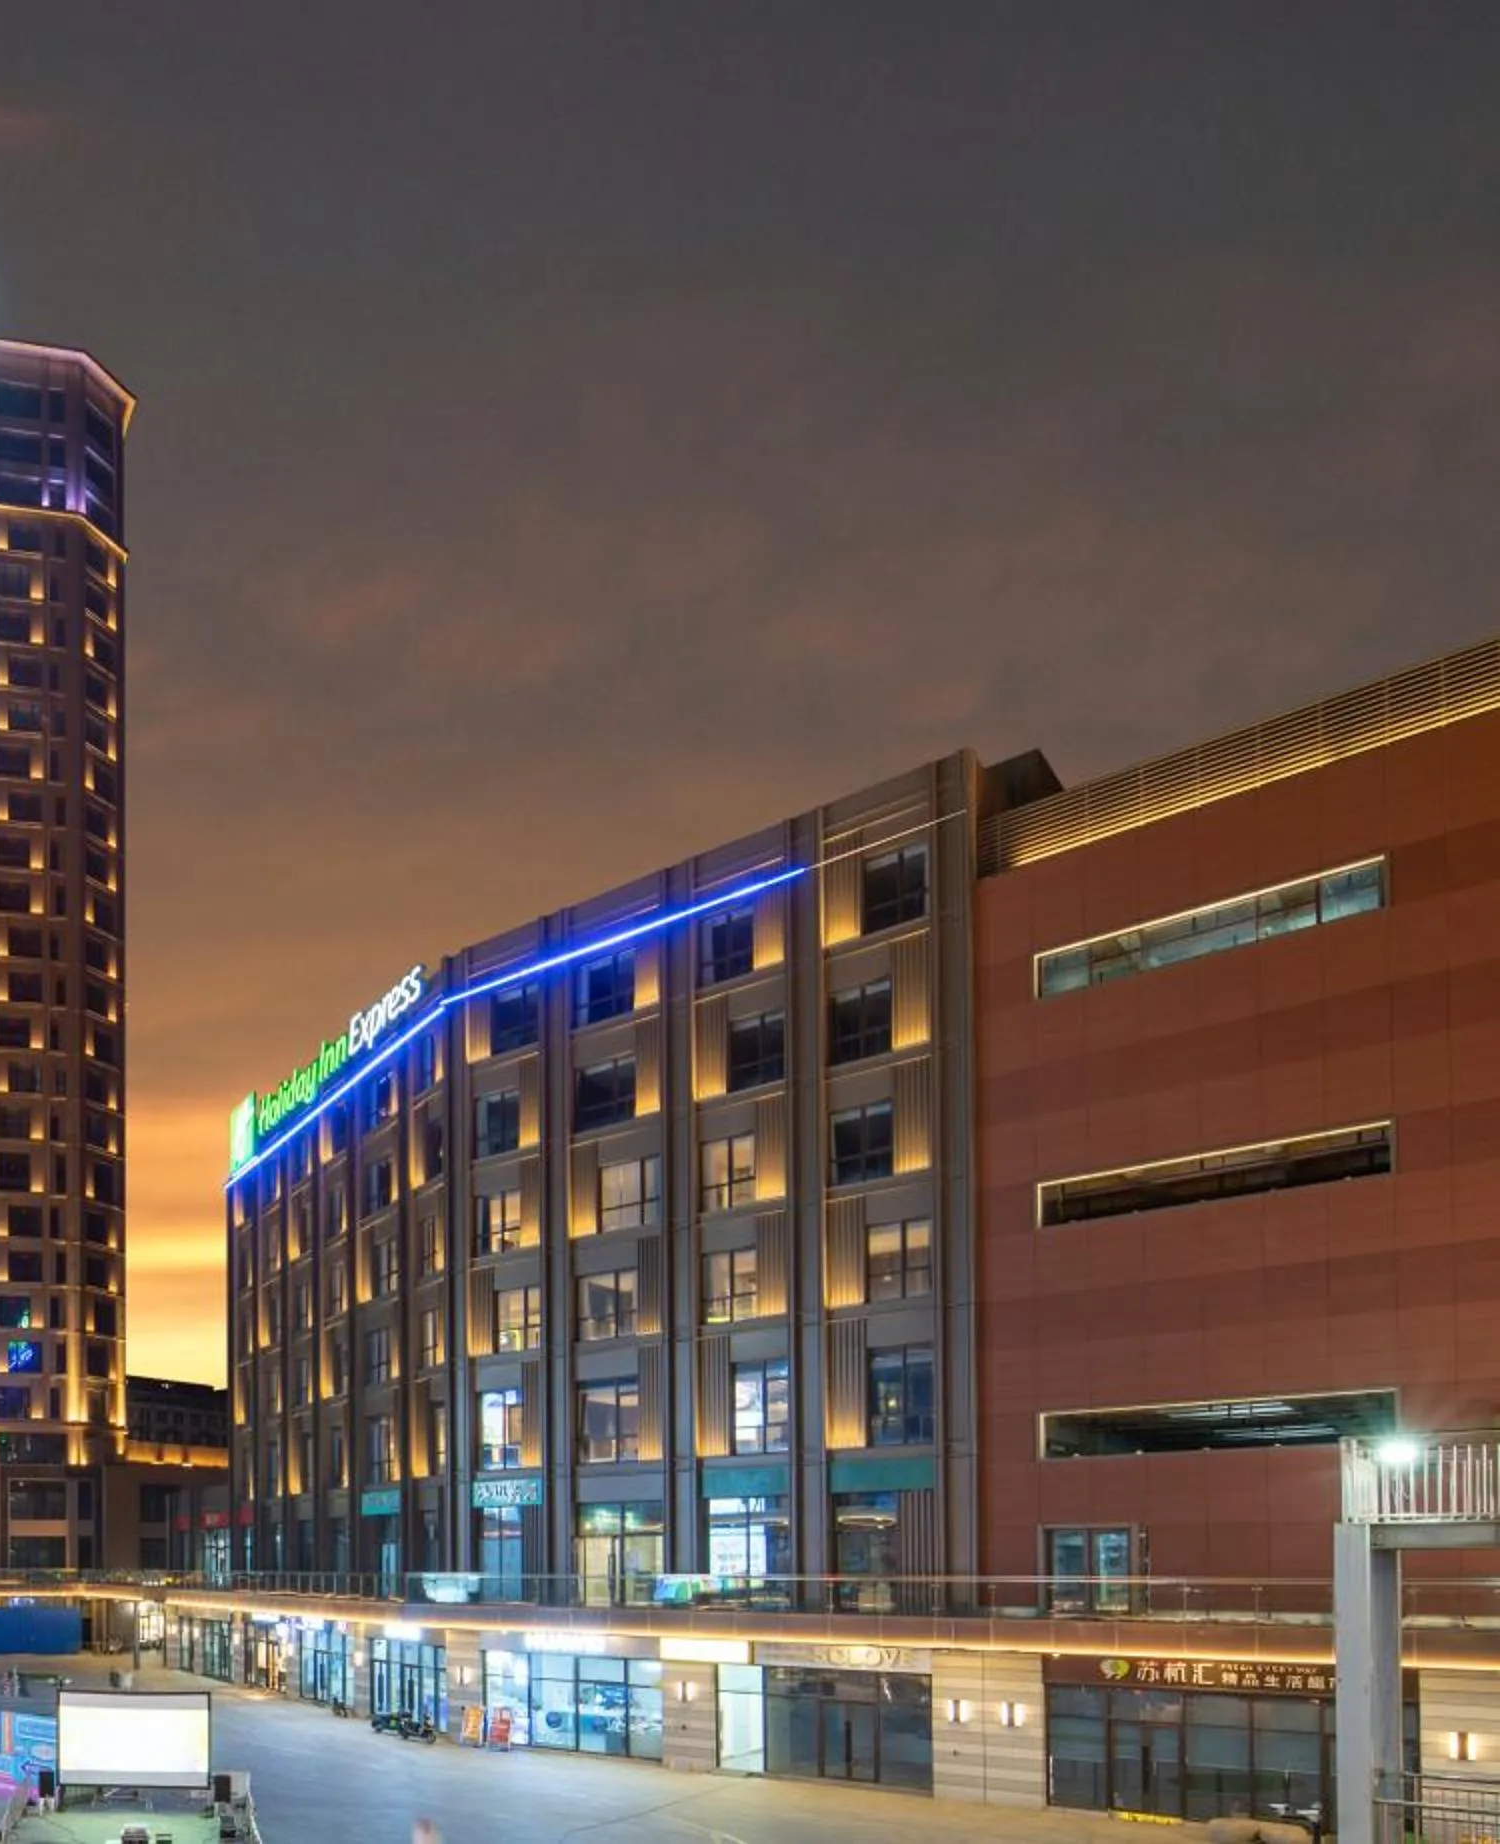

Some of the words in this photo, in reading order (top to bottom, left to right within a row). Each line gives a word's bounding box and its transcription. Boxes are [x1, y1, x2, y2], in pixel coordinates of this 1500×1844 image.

[258, 1068, 317, 1136] Holiday
[319, 1035, 347, 1082] Inn
[348, 965, 422, 1056] Express
[1136, 1660, 1214, 1685] 苏杭汇
